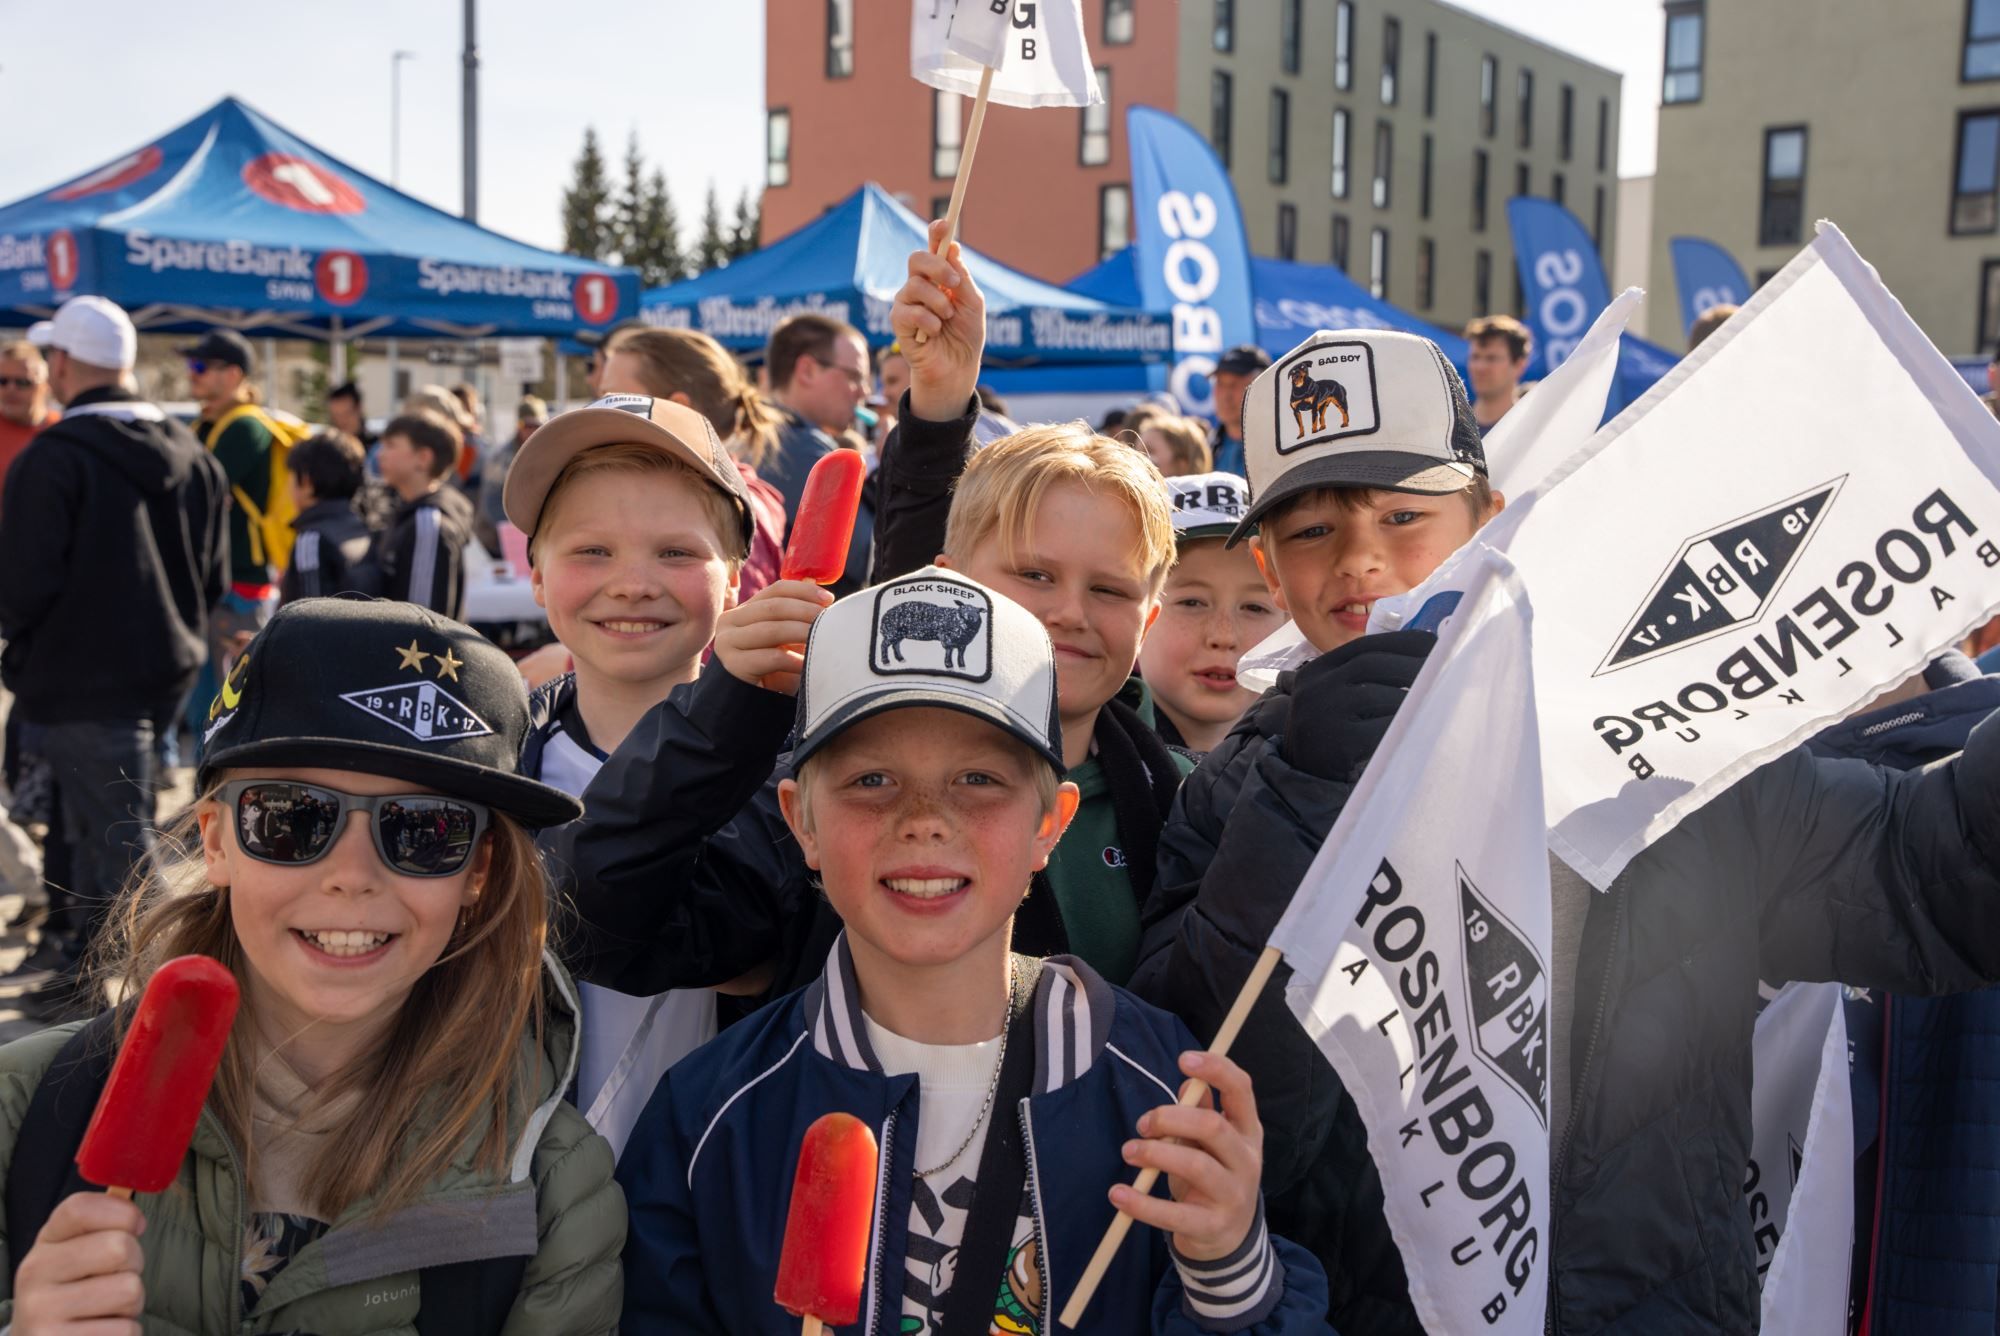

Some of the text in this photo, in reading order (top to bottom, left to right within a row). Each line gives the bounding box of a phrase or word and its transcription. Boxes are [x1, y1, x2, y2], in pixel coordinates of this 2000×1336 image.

[126, 228, 352, 296] SpareBank 1
[418, 256, 605, 315] SpareBank 1
[1318, 354, 1361, 366] BAD BOY
[893, 584, 975, 599] BLACK SHEEP
[366, 696, 476, 731] 19 RBK 17
[1466, 909, 1489, 943] 19
[1486, 961, 1544, 1070] RBK
[1355, 856, 1538, 1297] ROSENBORG
[1341, 958, 1508, 1325] ALLKLUB
